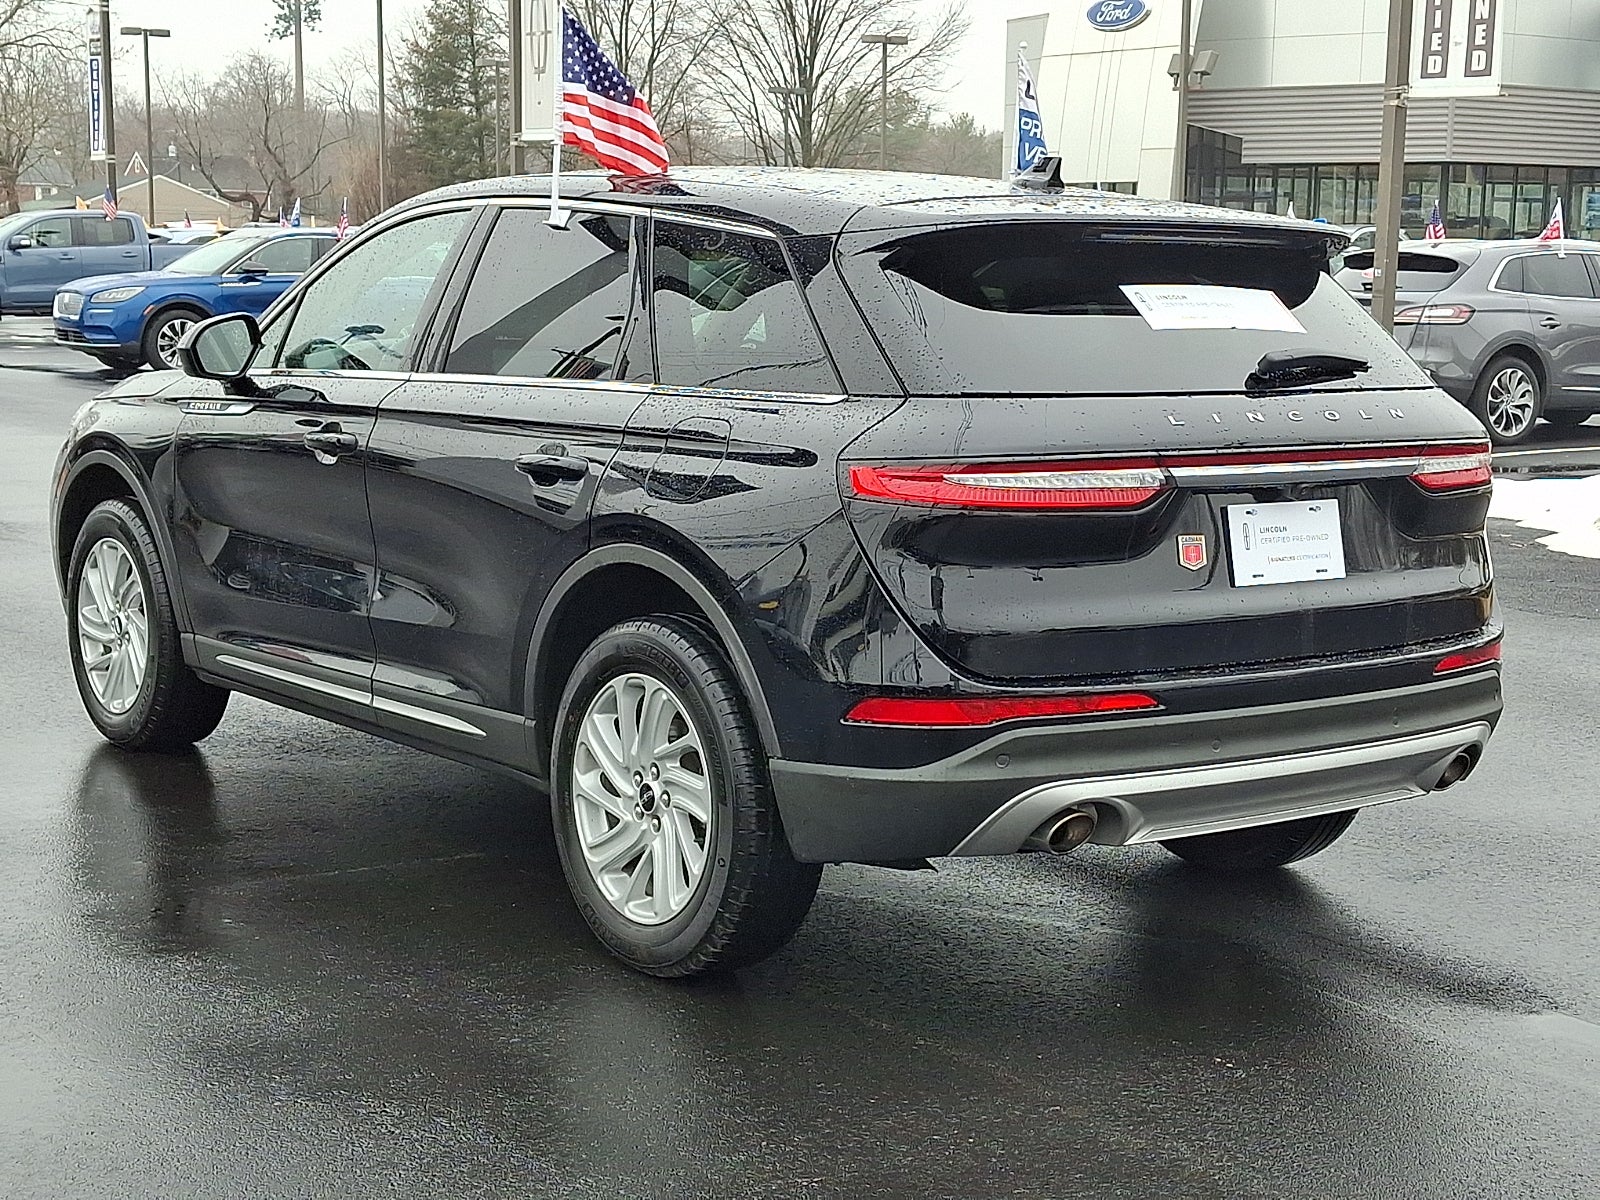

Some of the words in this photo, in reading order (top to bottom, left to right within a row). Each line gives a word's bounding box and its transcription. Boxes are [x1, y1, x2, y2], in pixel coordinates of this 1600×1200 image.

[1096, 0, 1132, 22] Ford
[1426, 0, 1443, 74] IED
[1167, 407, 1405, 426] LINCOLN
[1259, 525, 1288, 534] LINCOLN
[1260, 536, 1291, 545] CERTIFIED
[1292, 533, 1329, 543] PRE-OWNED
